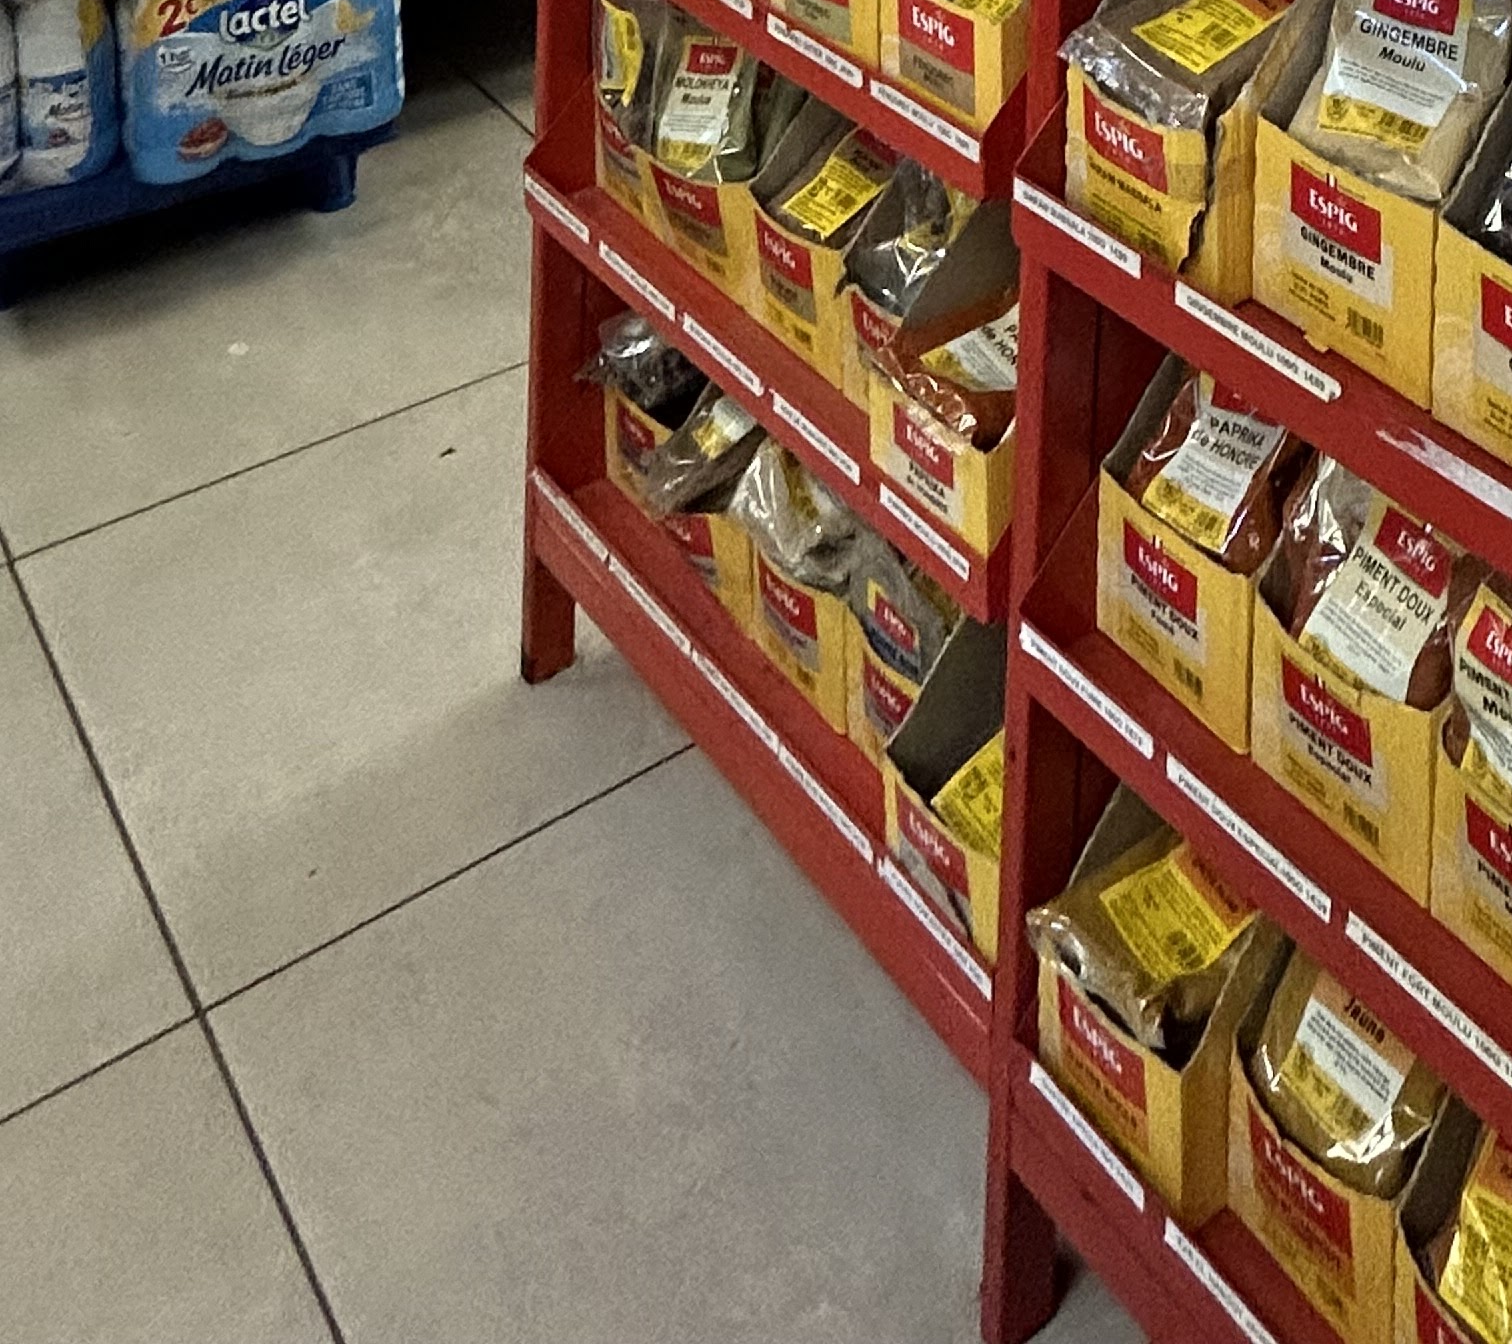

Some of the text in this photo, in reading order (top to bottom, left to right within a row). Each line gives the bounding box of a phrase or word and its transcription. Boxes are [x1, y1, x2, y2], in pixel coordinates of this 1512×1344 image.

[911, 5, 956, 48] ESPIG
[1359, 16, 1459, 63] GINGEMBRE
[186, 35, 347, 98] Matin léger
[1377, 45, 1427, 74] Moulu
[1308, 187, 1359, 233] ESPIG
[1299, 225, 1376, 281] GINGEMBRE
[1396, 530, 1437, 573] ESPIG
[1352, 545, 1436, 626] PIMENT DOUX
[1300, 686, 1351, 737] ESPIG
